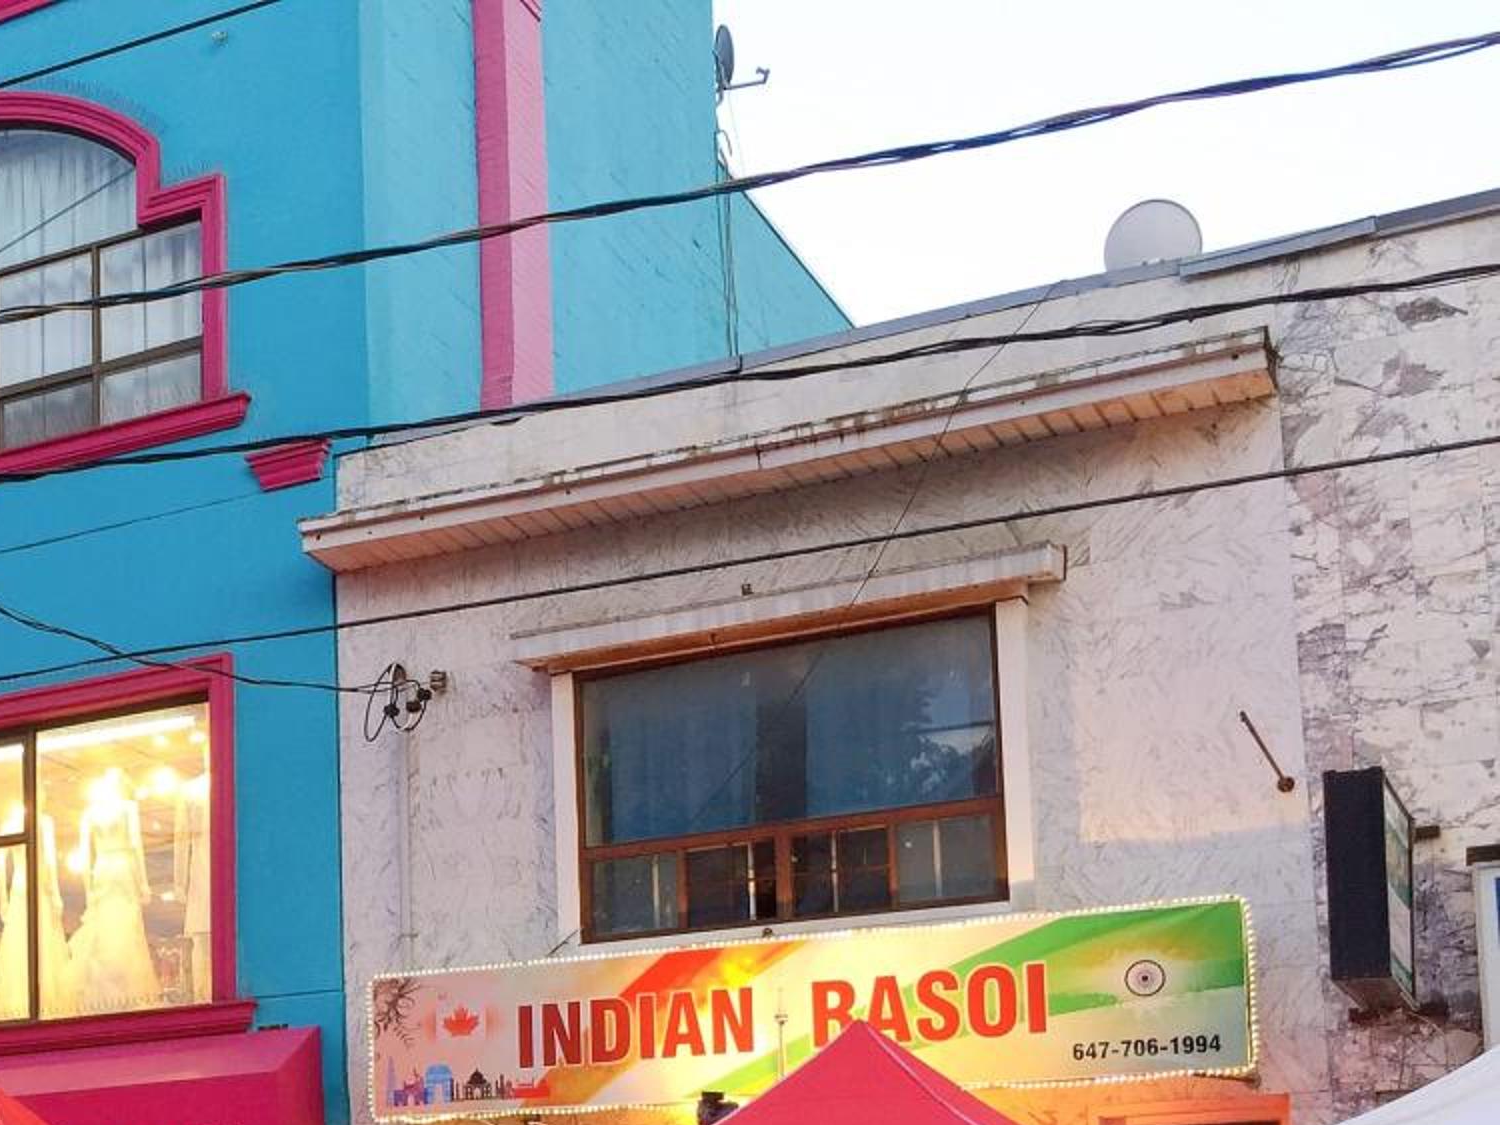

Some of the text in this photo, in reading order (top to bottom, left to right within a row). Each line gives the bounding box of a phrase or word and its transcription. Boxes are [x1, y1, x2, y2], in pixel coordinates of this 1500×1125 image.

[518, 963, 1048, 1069] INDIAN RASOI
[1073, 1034, 1222, 1062] 647-706-1994
